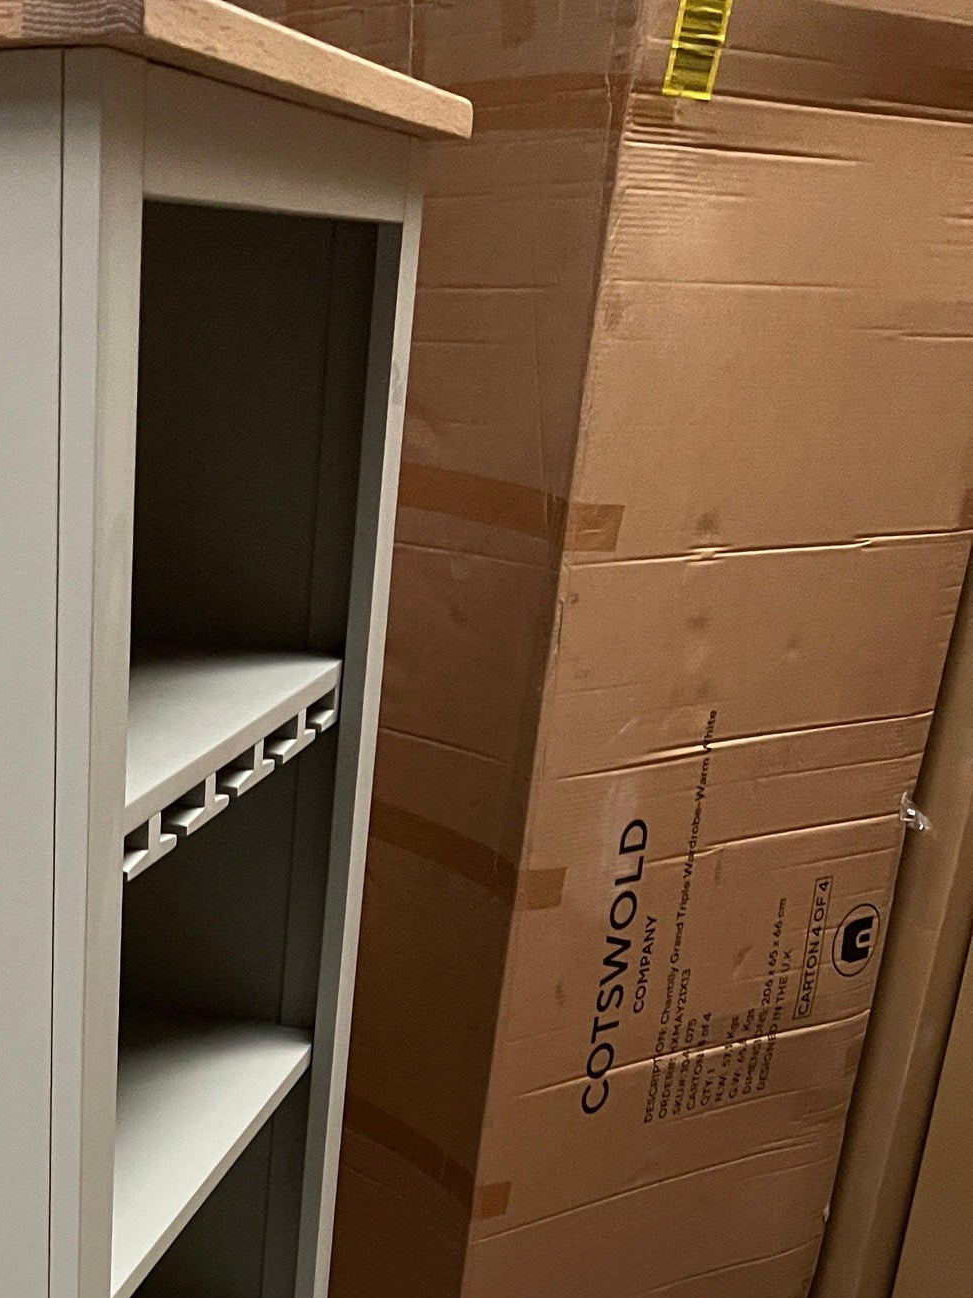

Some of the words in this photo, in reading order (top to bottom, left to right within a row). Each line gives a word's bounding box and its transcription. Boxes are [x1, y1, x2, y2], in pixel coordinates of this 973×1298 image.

[701, 710, 717, 753] White
[682, 756, 711, 879] Wardrobe-Warm
[676, 880, 692, 920] Triple
[818, 881, 829, 891] 4
[813, 896, 826, 922] OF
[670, 921, 684, 964] Grand
[761, 979, 773, 1006] 206
[768, 950, 778, 967] 65
[773, 920, 783, 938] 66
[778, 897, 787, 918] cm
[811, 926, 823, 937] 4
[581, 818, 648, 1114] COTSWOLD
[632, 916, 658, 1014] COMPANY
[797, 940, 820, 1015] CARTON
[661, 966, 679, 1024] Chantilly
[776, 976, 788, 1002] THE
[701, 1024, 710, 1038] of
[703, 1012, 712, 1022] 4
[727, 1015, 740, 1039] Kgs
[742, 1008, 755, 1031] Kgs
[773, 1006, 783, 1020] IN
[681, 1018, 697, 1073] 104.075
[756, 1023, 778, 1090] DESIGNED
[644, 1028, 667, 1123] DESCRIPTON:
[659, 1056, 676, 1119] ORDER#:
